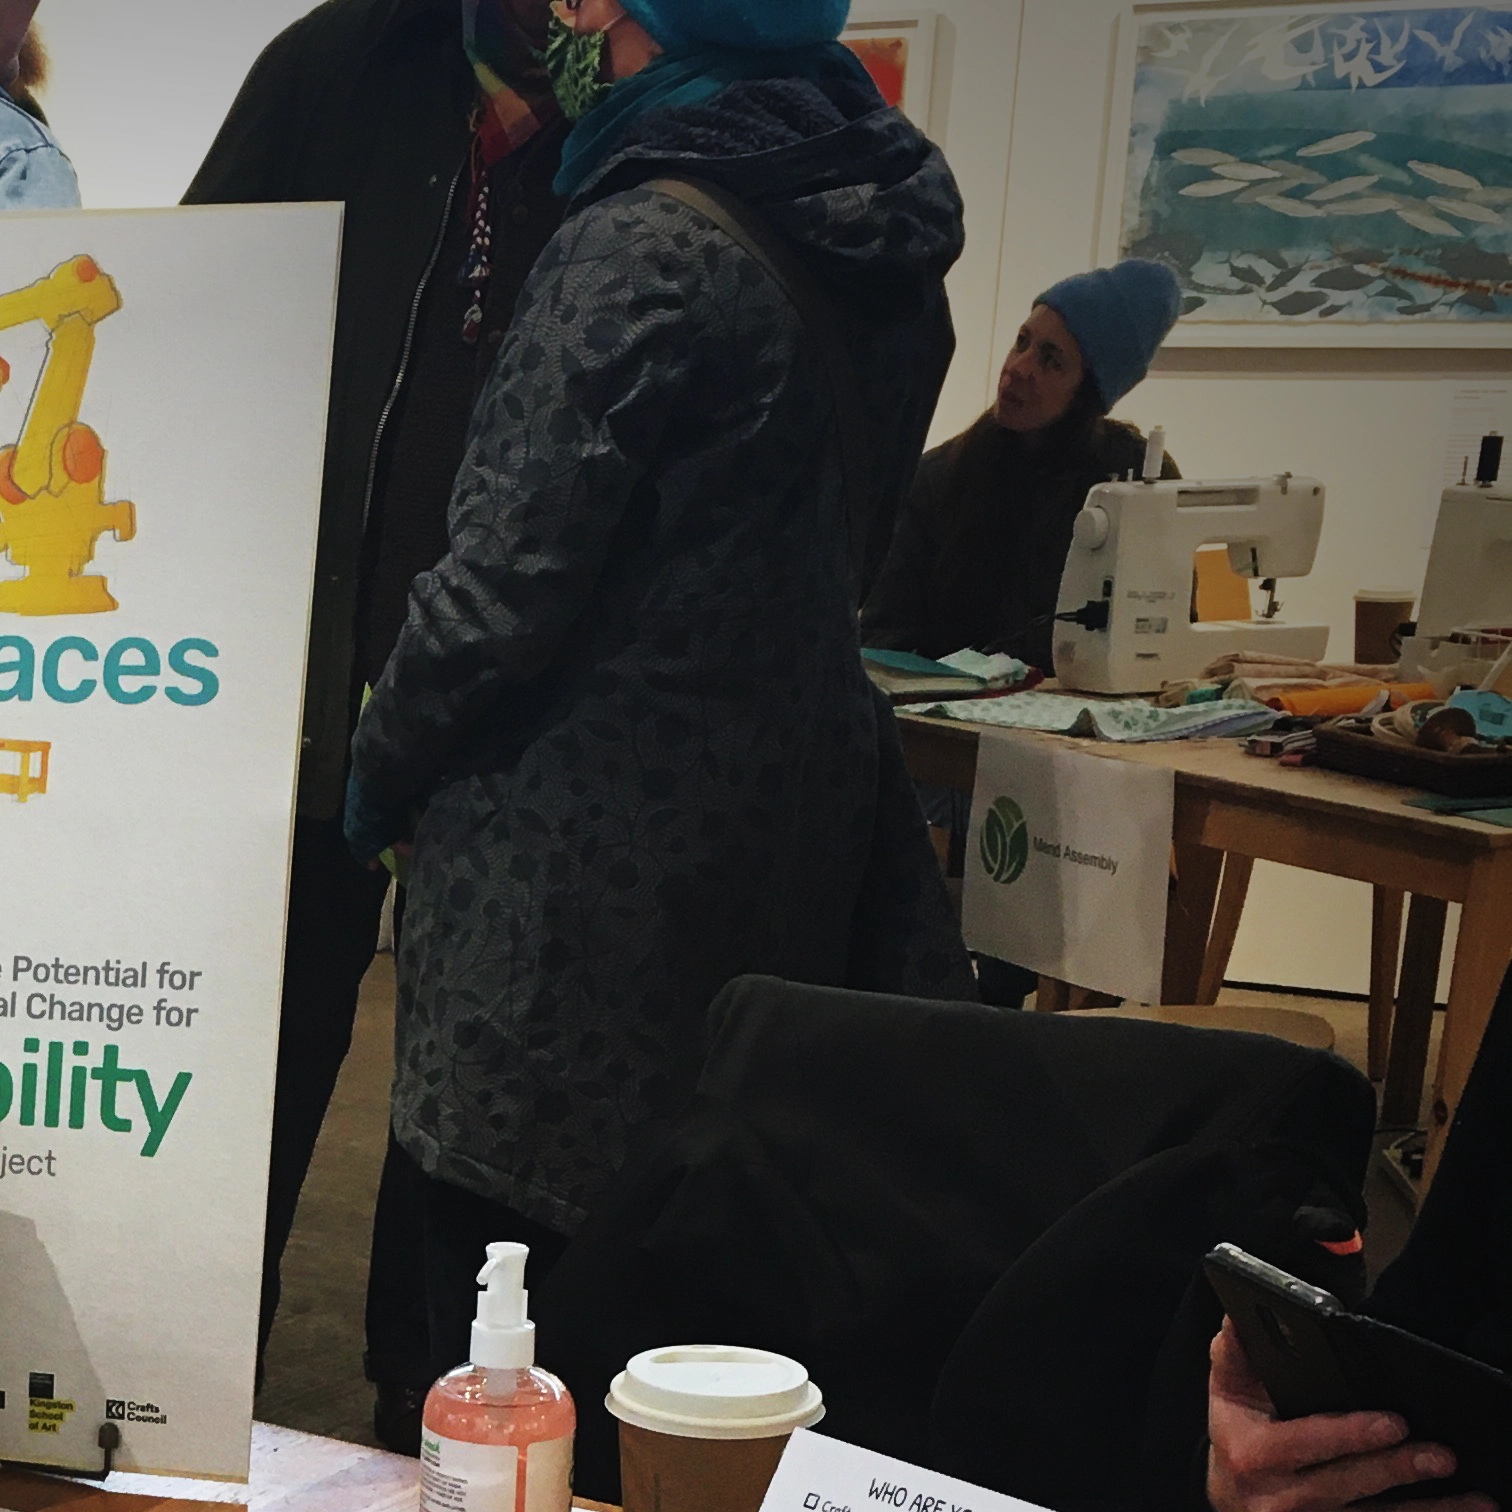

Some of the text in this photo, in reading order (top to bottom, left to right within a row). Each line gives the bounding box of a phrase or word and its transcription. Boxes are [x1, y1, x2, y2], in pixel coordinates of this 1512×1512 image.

[1033, 836, 1119, 876] Mend Assembly
[12, 955, 147, 989] Potential
[156, 961, 202, 991] for
[26, 992, 144, 1032] Change
[153, 998, 199, 1028] for
[29, 1399, 74, 1411] Kingston
[127, 1401, 160, 1413] Crafts
[29, 1409, 64, 1421] School
[126, 1412, 167, 1425] Council
[29, 1421, 57, 1432] of Art
[867, 1476, 908, 1508] WHO
